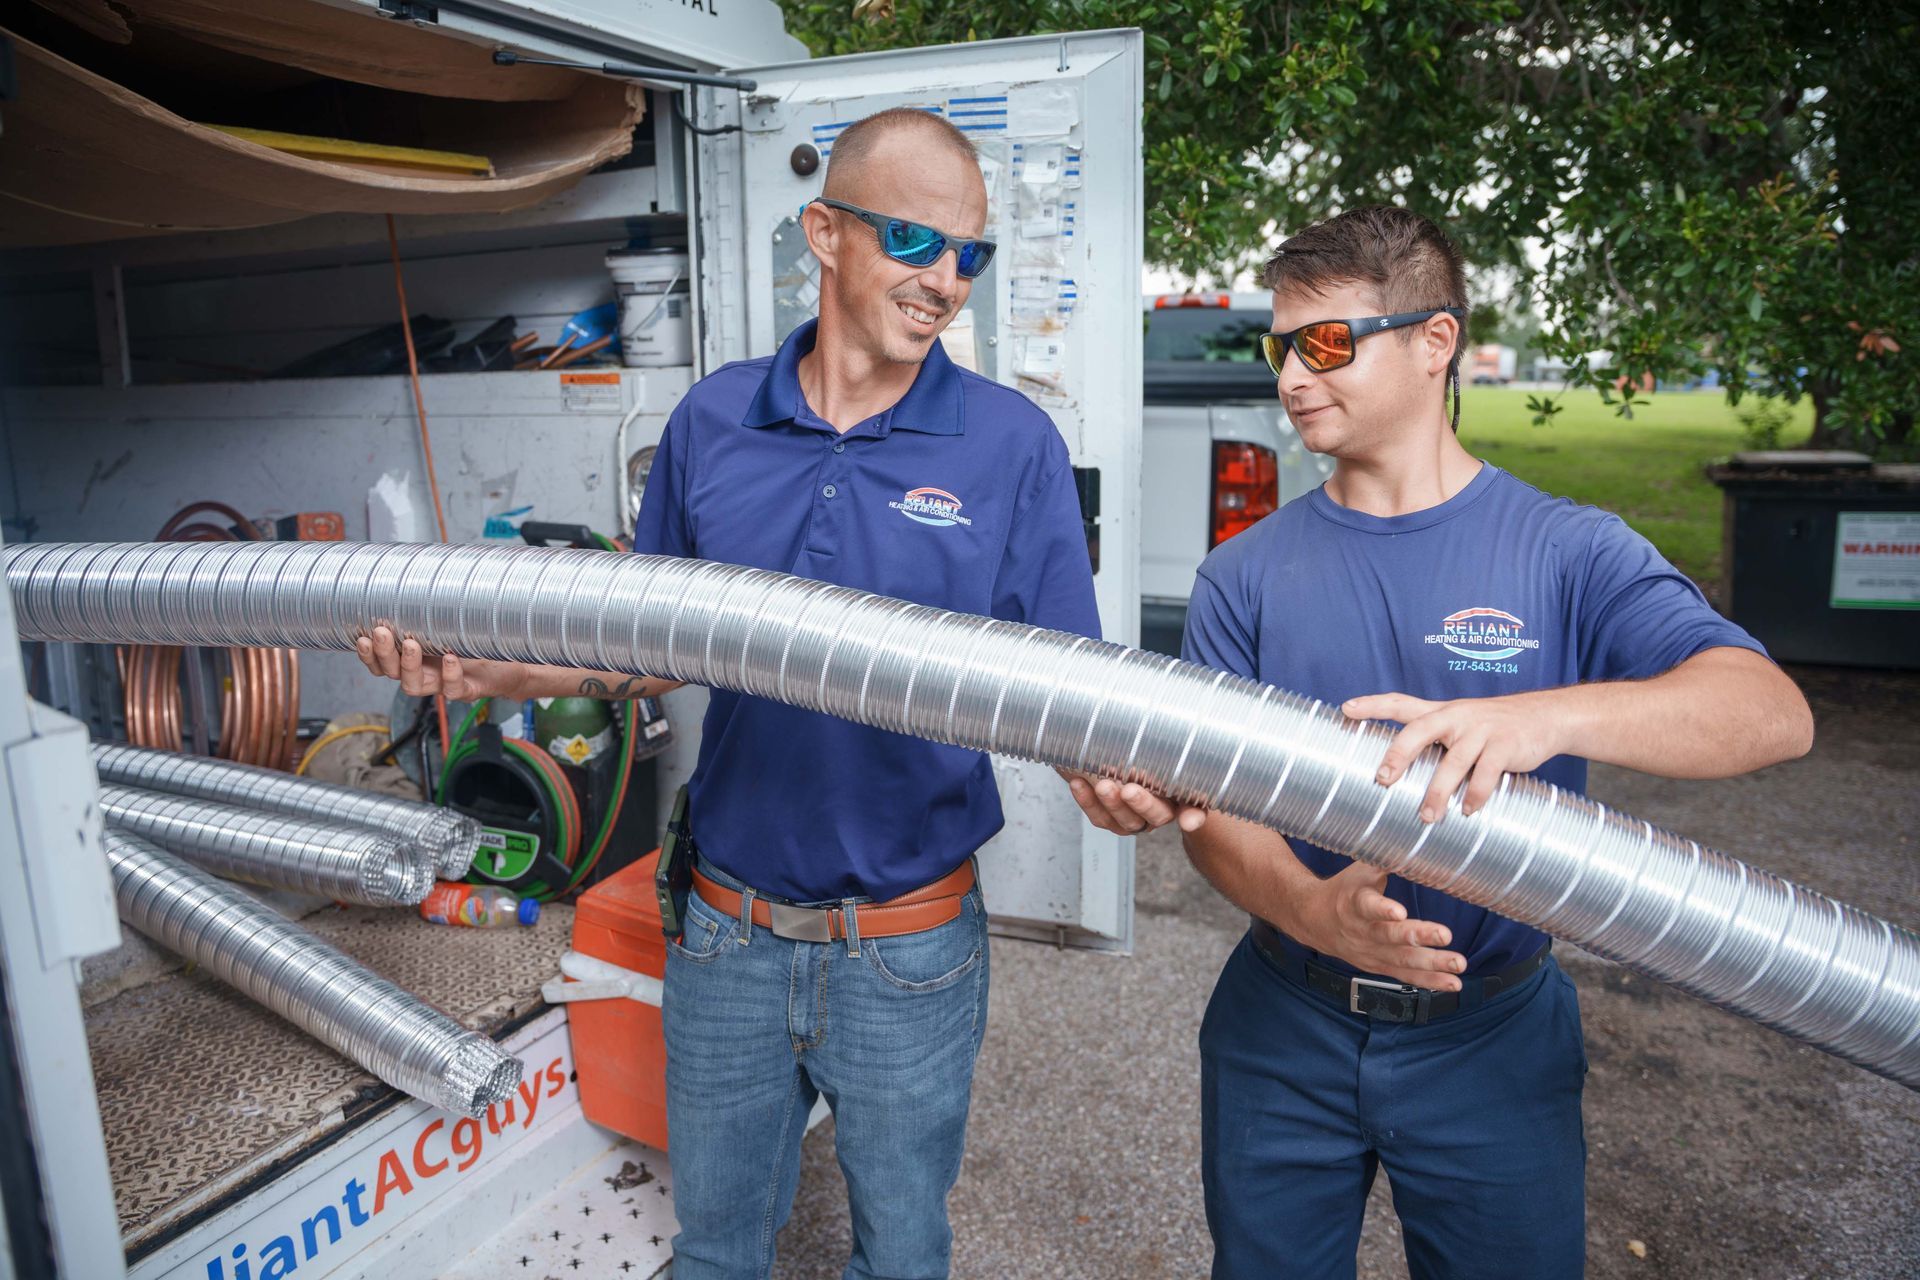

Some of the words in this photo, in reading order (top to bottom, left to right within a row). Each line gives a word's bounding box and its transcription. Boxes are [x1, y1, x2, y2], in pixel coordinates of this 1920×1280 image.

[904, 494, 961, 514] RELIANT
[889, 501, 912, 511] HEATING
[930, 508, 971, 526] CONDITIONING
[1443, 621, 1522, 638] RELIANT
[1424, 634, 1458, 643] HEATING
[1460, 635, 1466, 643] &
[1468, 635, 1482, 644] AIR
[1484, 636, 1539, 649] CONDITIONING
[1448, 660, 1518, 674] 727-543-2134
